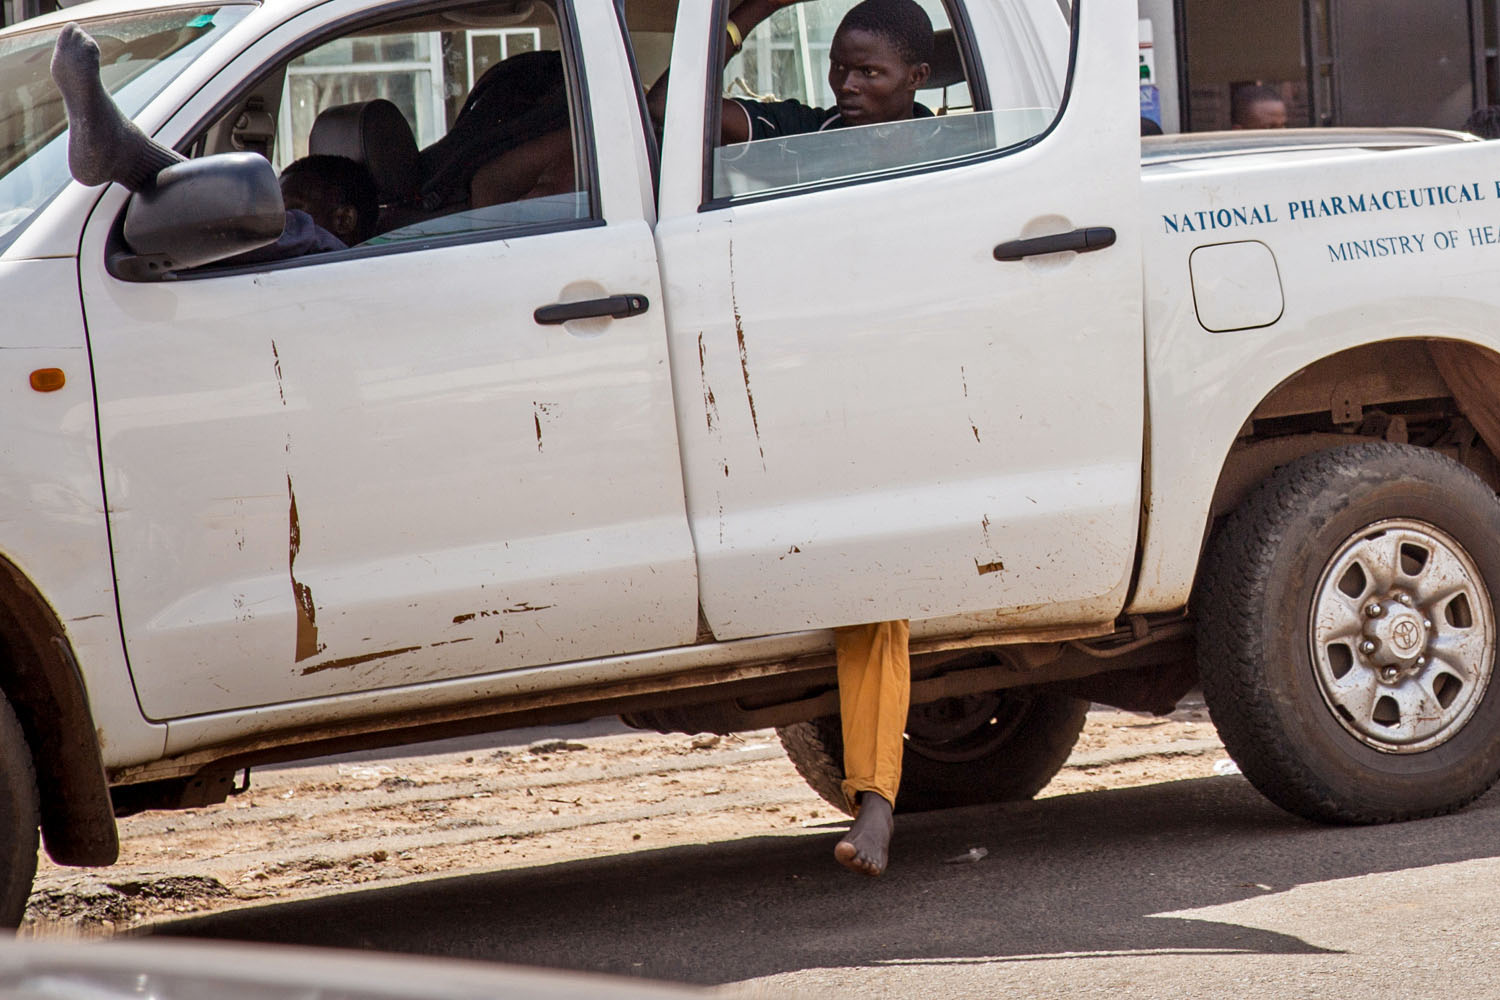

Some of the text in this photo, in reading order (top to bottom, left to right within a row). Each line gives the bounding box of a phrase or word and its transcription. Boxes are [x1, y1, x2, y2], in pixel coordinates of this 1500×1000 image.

[1162, 204, 1278, 234] NATIONAL
[1288, 182, 1486, 220] PHARMACEUTICAL
[1327, 233, 1425, 263] MINISTRY
[1433, 230, 1460, 251] OF
